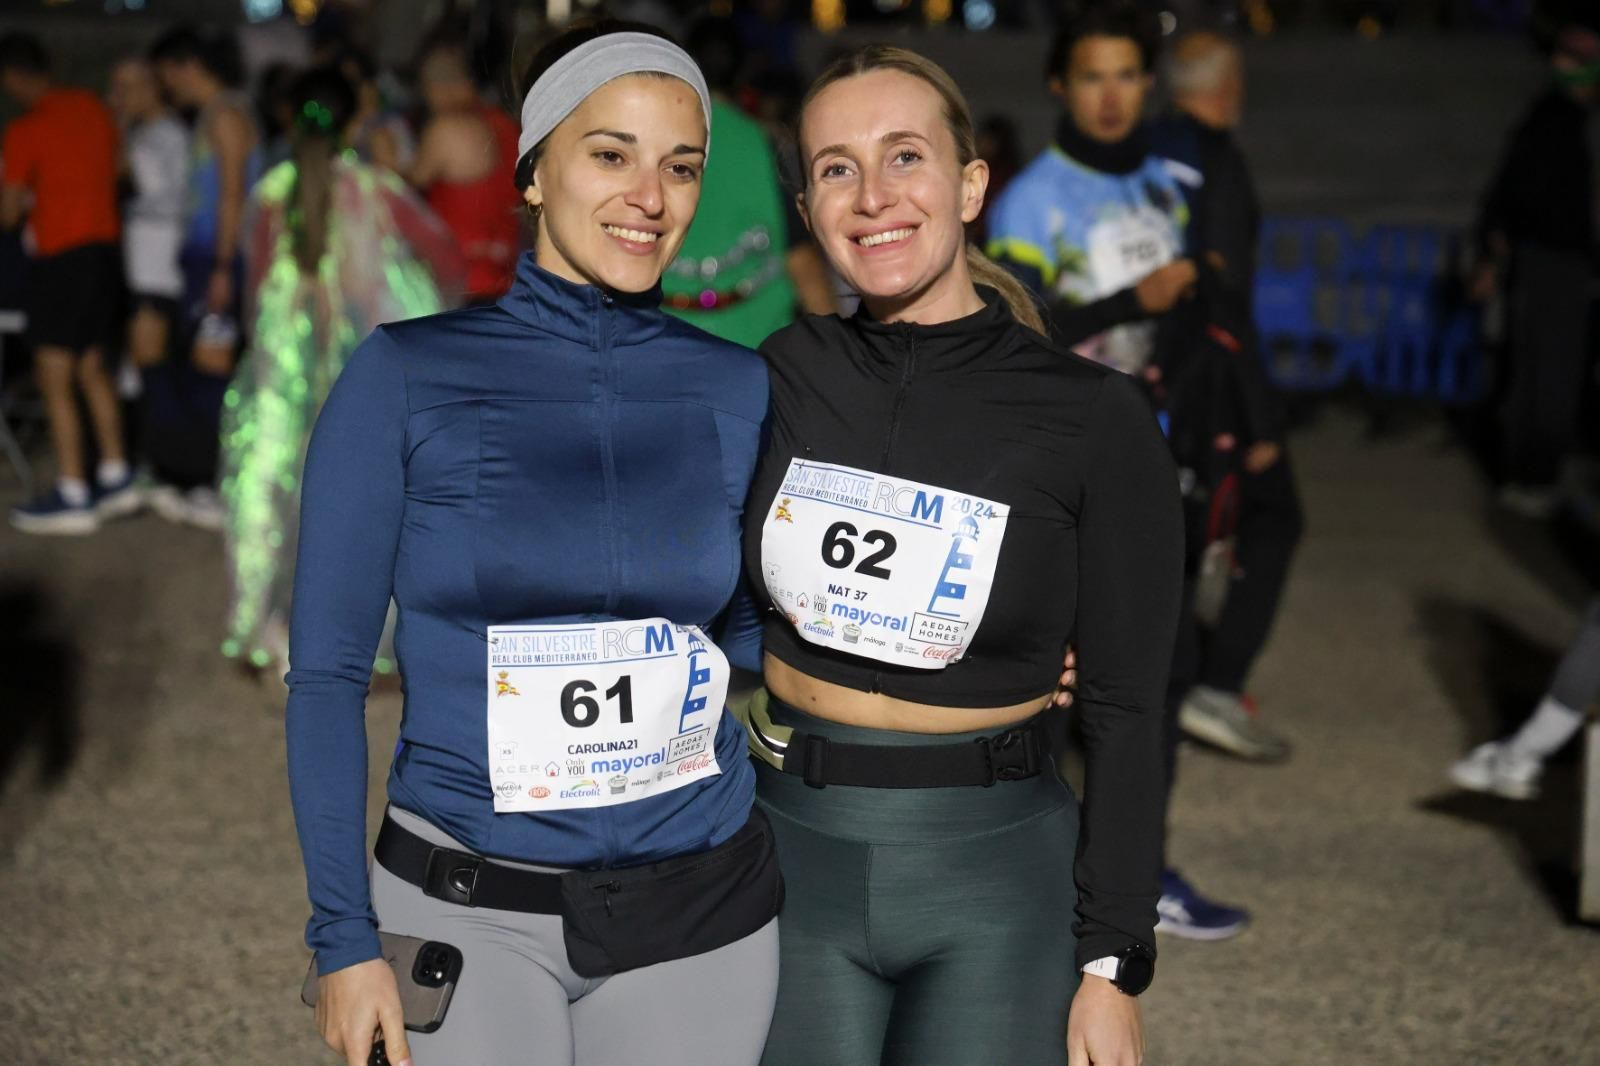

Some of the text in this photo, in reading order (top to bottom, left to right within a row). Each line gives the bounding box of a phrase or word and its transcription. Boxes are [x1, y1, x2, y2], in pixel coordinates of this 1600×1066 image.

[783, 483, 797, 493] REAL
[798, 486, 815, 496] CLUB
[788, 468, 873, 498] SAN SILVESTRE
[872, 481, 944, 524] RCM
[821, 521, 897, 580] 62
[828, 583, 868, 601] NAT 37
[813, 601, 827, 613] YOU
[831, 602, 908, 632] mayoral
[921, 620, 960, 633] AEDAS
[492, 633, 597, 653] SAN SILVESTRE
[603, 623, 675, 659] RCM
[919, 629, 957, 642] HOMES
[492, 654, 511, 664] REAL
[513, 653, 533, 664] CLUB
[560, 674, 634, 728] 61
[567, 739, 638, 755] CAROLINA21
[675, 735, 703, 749] AEDAS
[673, 743, 701, 757] HOMES
[591, 747, 665, 774] mayoral
[495, 764, 540, 774] ACER
[567, 765, 585, 776] YOU
[560, 789, 600, 799] Electrolit
